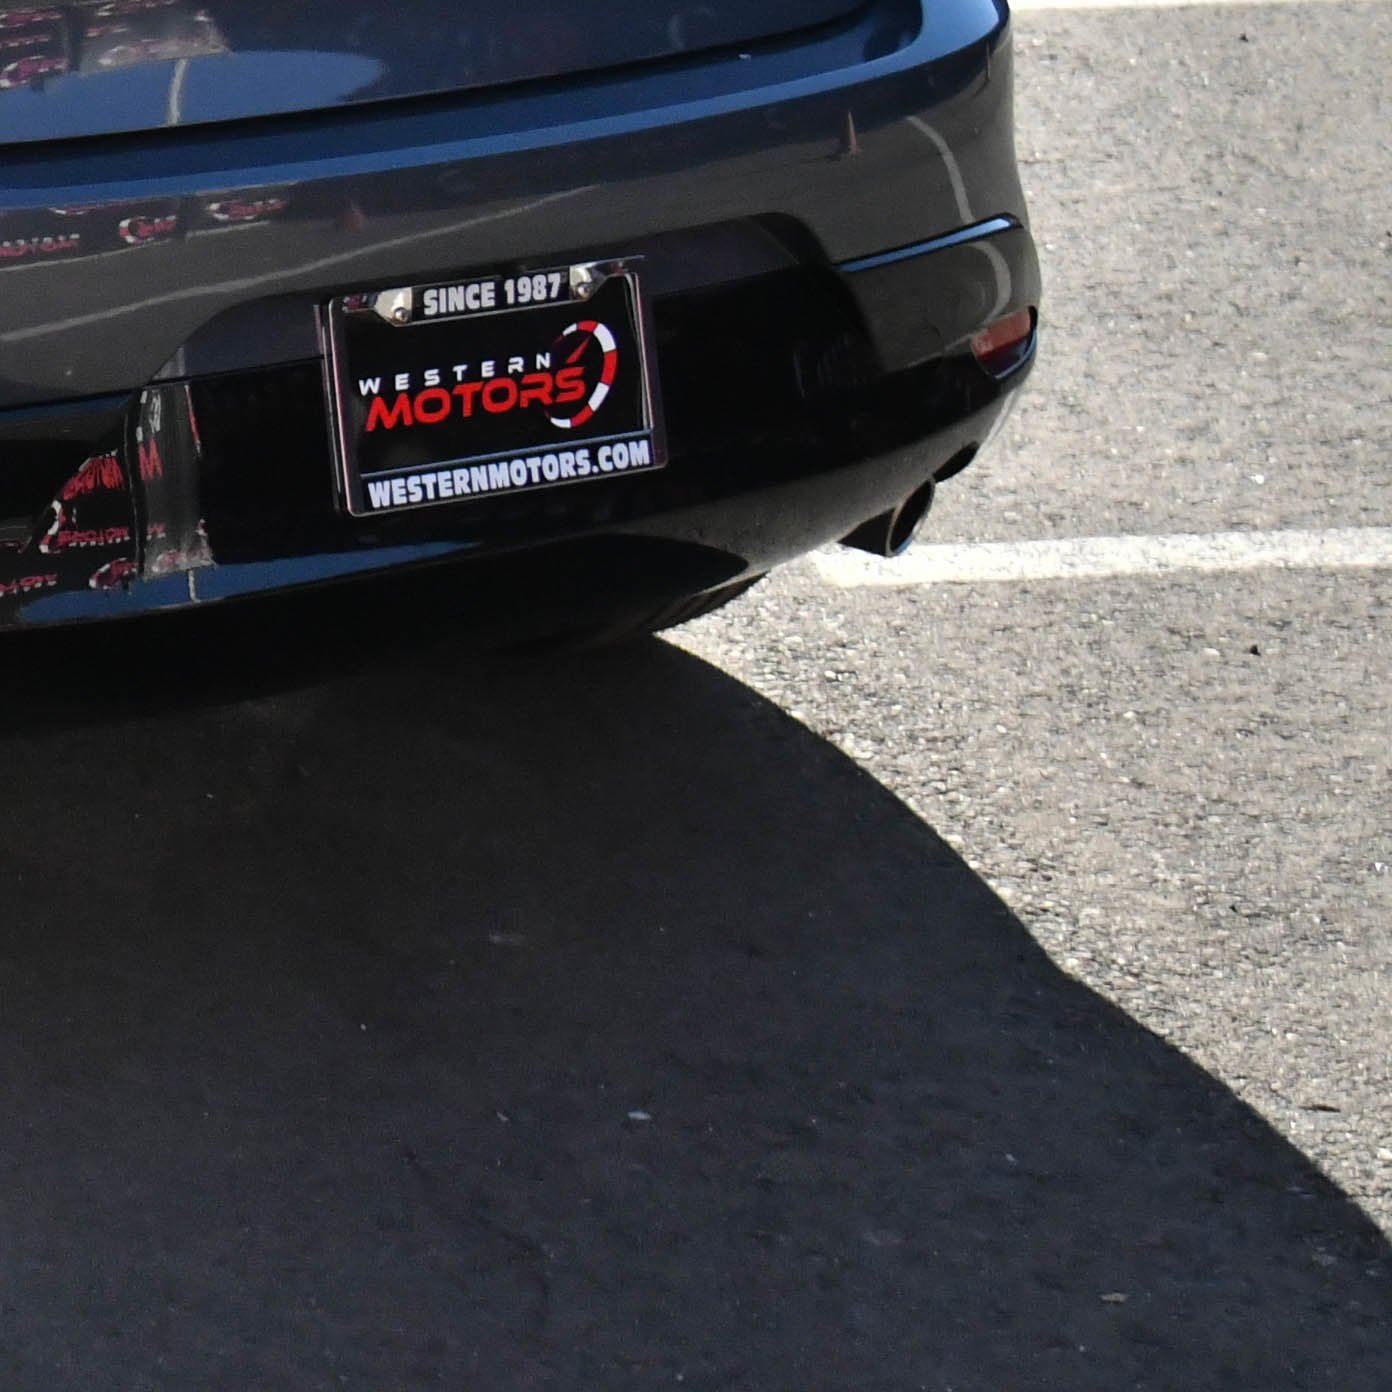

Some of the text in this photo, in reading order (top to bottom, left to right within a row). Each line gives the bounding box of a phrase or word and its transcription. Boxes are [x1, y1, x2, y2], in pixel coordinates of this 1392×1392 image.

[423, 273, 562, 316] SINCE 1987
[358, 352, 551, 396] WESTERN
[365, 366, 586, 432] MOTORS
[367, 439, 651, 509] WESTERNMOTORS.COM
